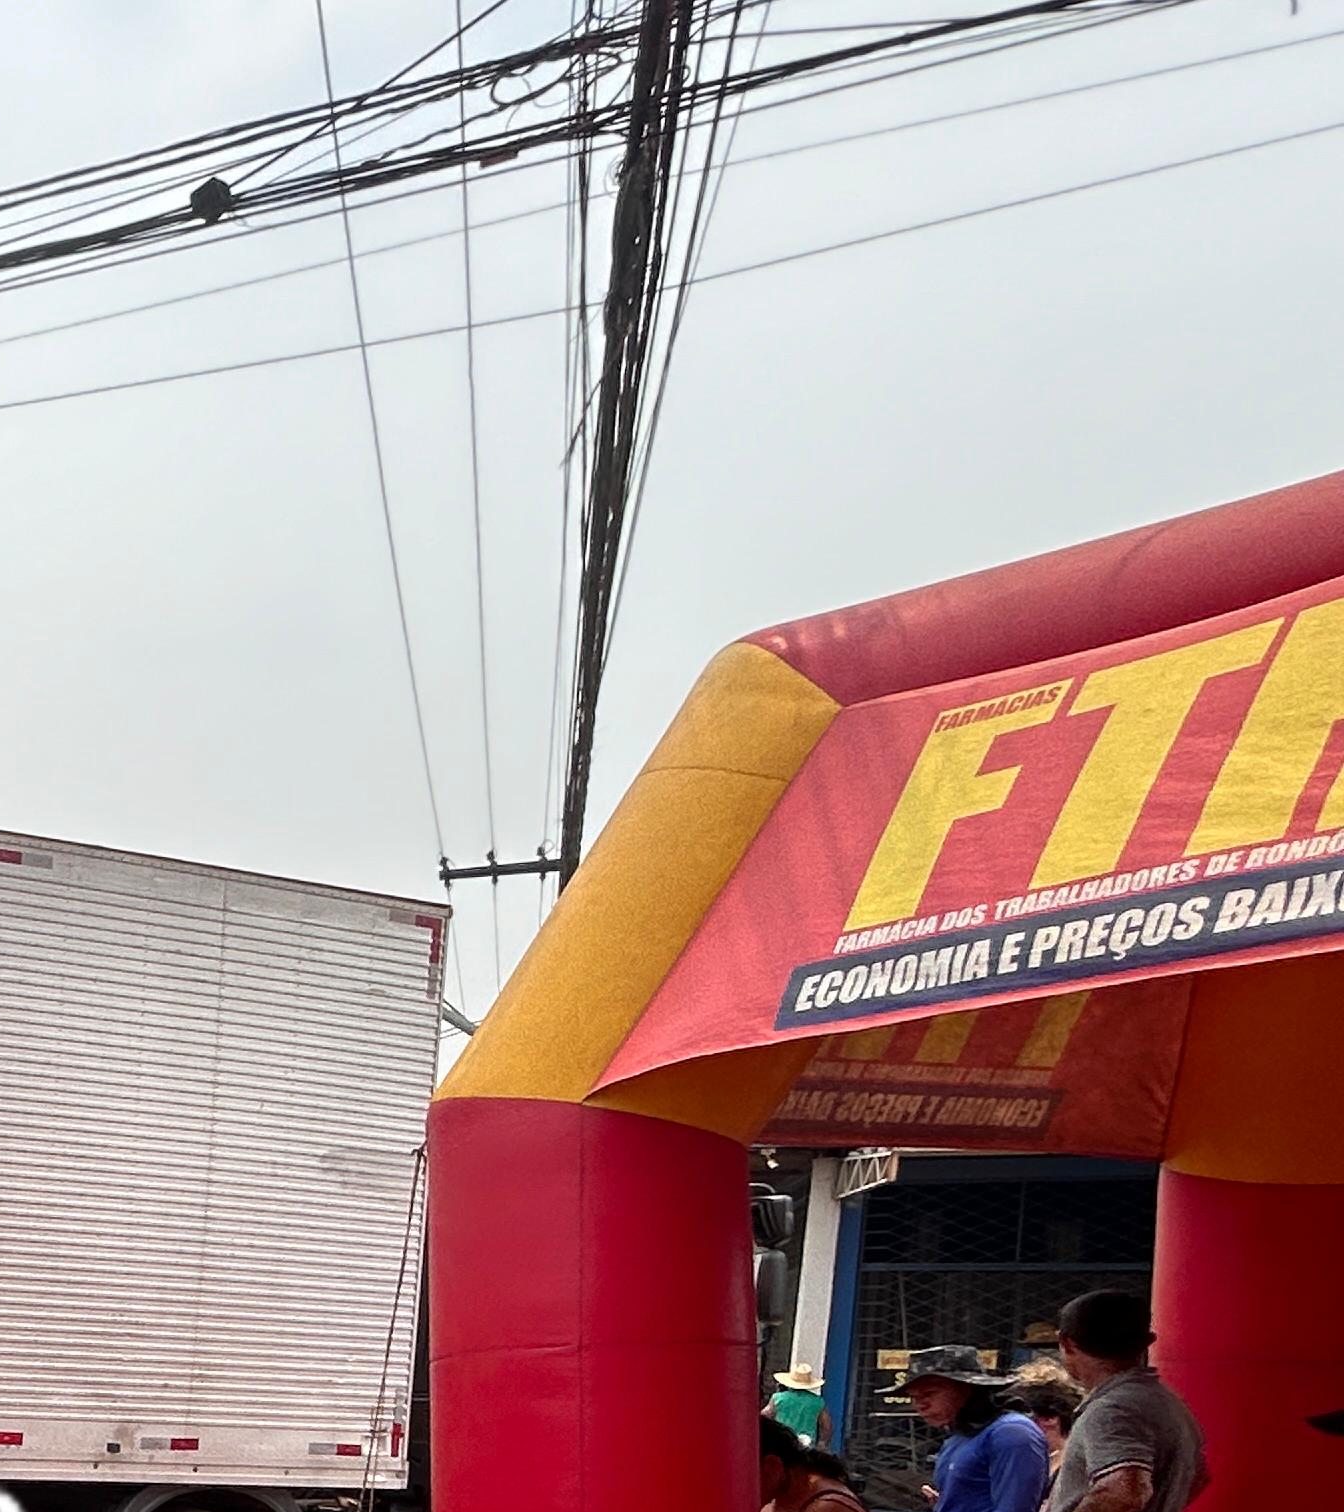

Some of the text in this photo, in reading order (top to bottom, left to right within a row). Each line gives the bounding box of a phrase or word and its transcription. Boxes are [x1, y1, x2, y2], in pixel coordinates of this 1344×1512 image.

[934, 685, 1063, 734] FARMÁCIAS
[794, 868, 1344, 1013] ECONOMIA E PREÇOS BAIX
[832, 915, 939, 955] FARMÁCIA
[939, 904, 988, 932] DOS
[994, 858, 1201, 921] TRABALHADORES
[1203, 850, 1245, 878] DE
